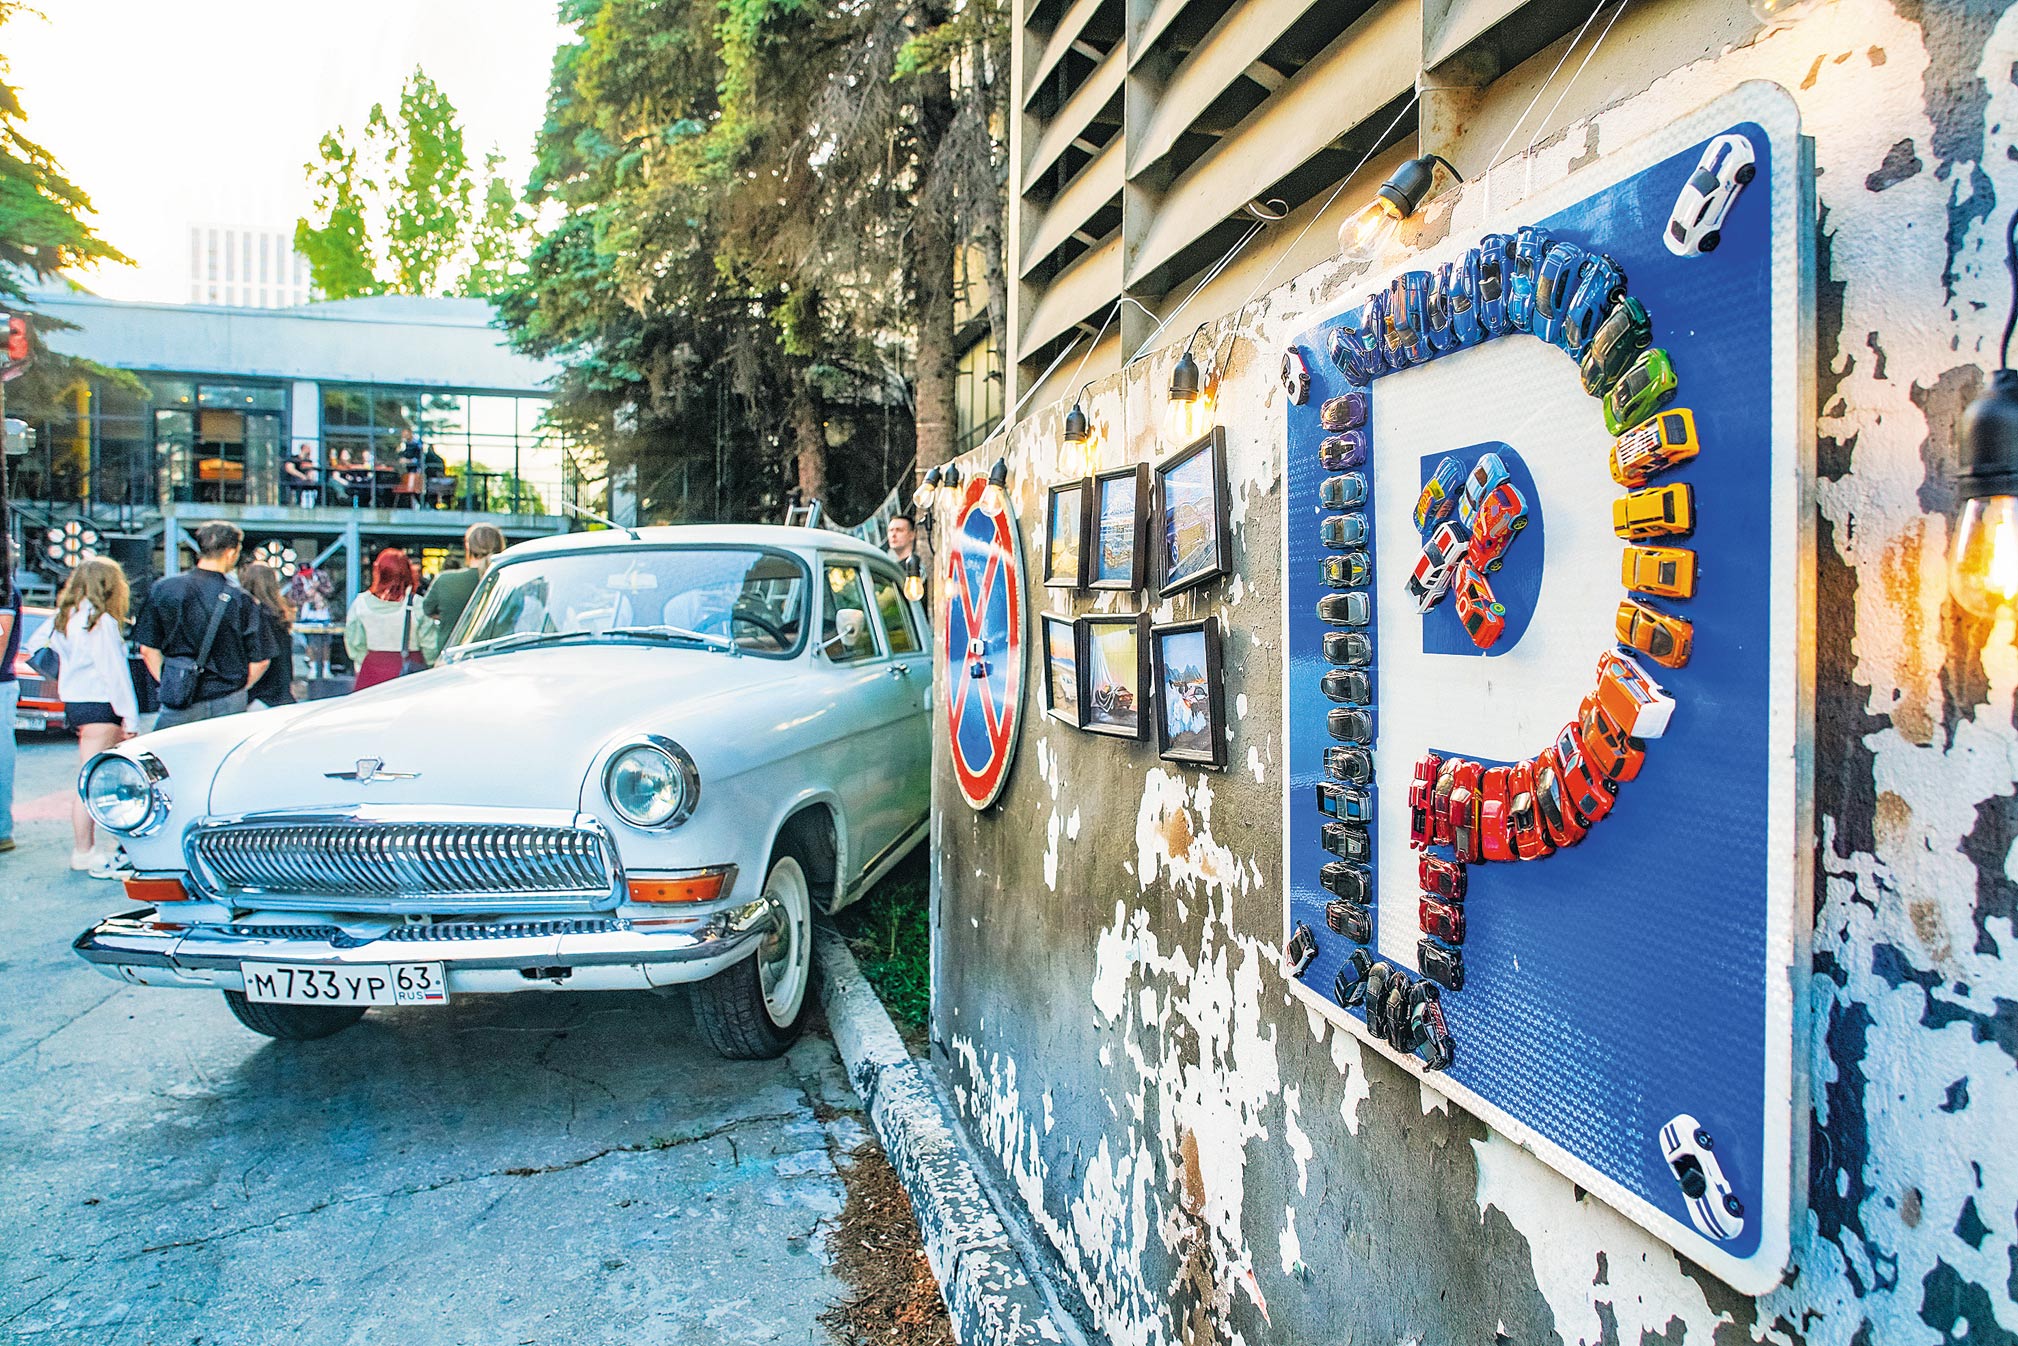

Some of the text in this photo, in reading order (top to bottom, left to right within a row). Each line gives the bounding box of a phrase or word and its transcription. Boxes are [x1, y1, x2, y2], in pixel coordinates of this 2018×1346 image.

[1366, 320, 1645, 985] P
[397, 966, 431, 990] 63
[398, 991, 424, 1000] RUS
